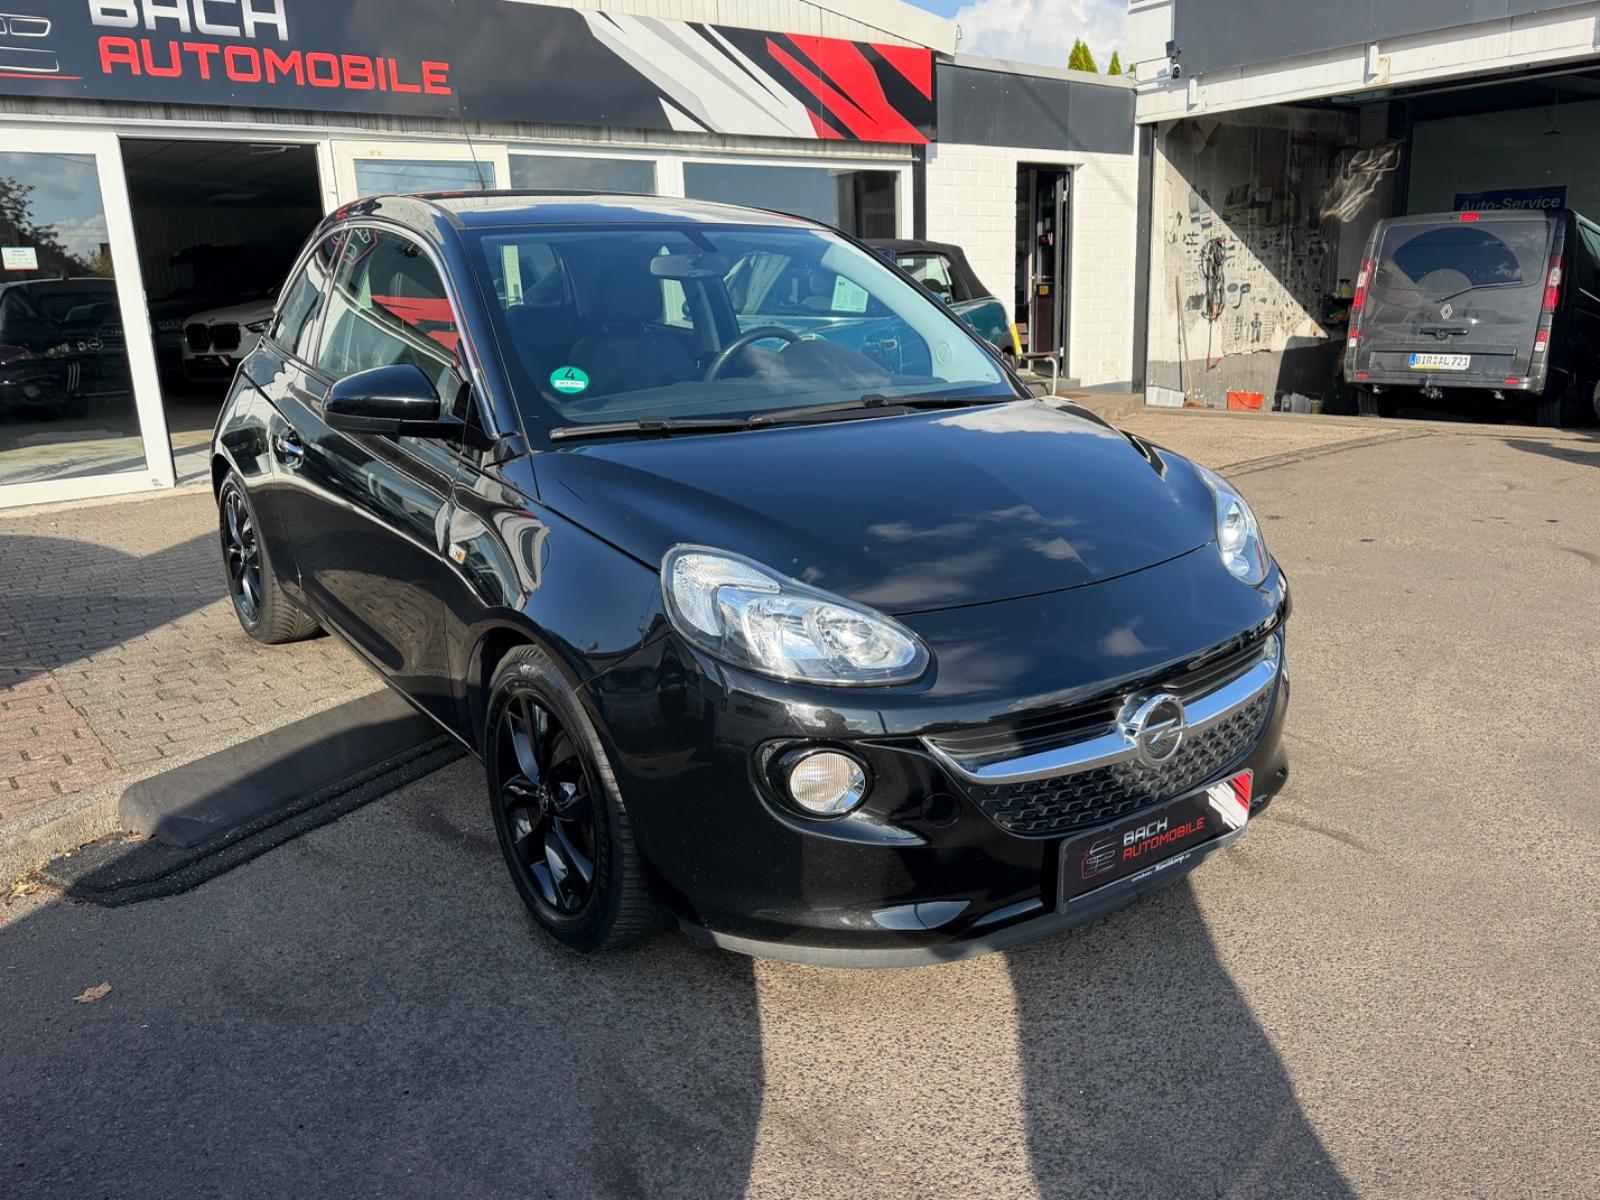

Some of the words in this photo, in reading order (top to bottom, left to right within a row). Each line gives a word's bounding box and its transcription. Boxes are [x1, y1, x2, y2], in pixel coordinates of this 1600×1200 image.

[97, 36, 453, 95] AUTOMOBILE
[1461, 196, 1560, 211] Auto-Service
[564, 368, 576, 381] 4
[1123, 817, 1168, 847] BACH
[1123, 817, 1205, 861] AUTOMOBILE
